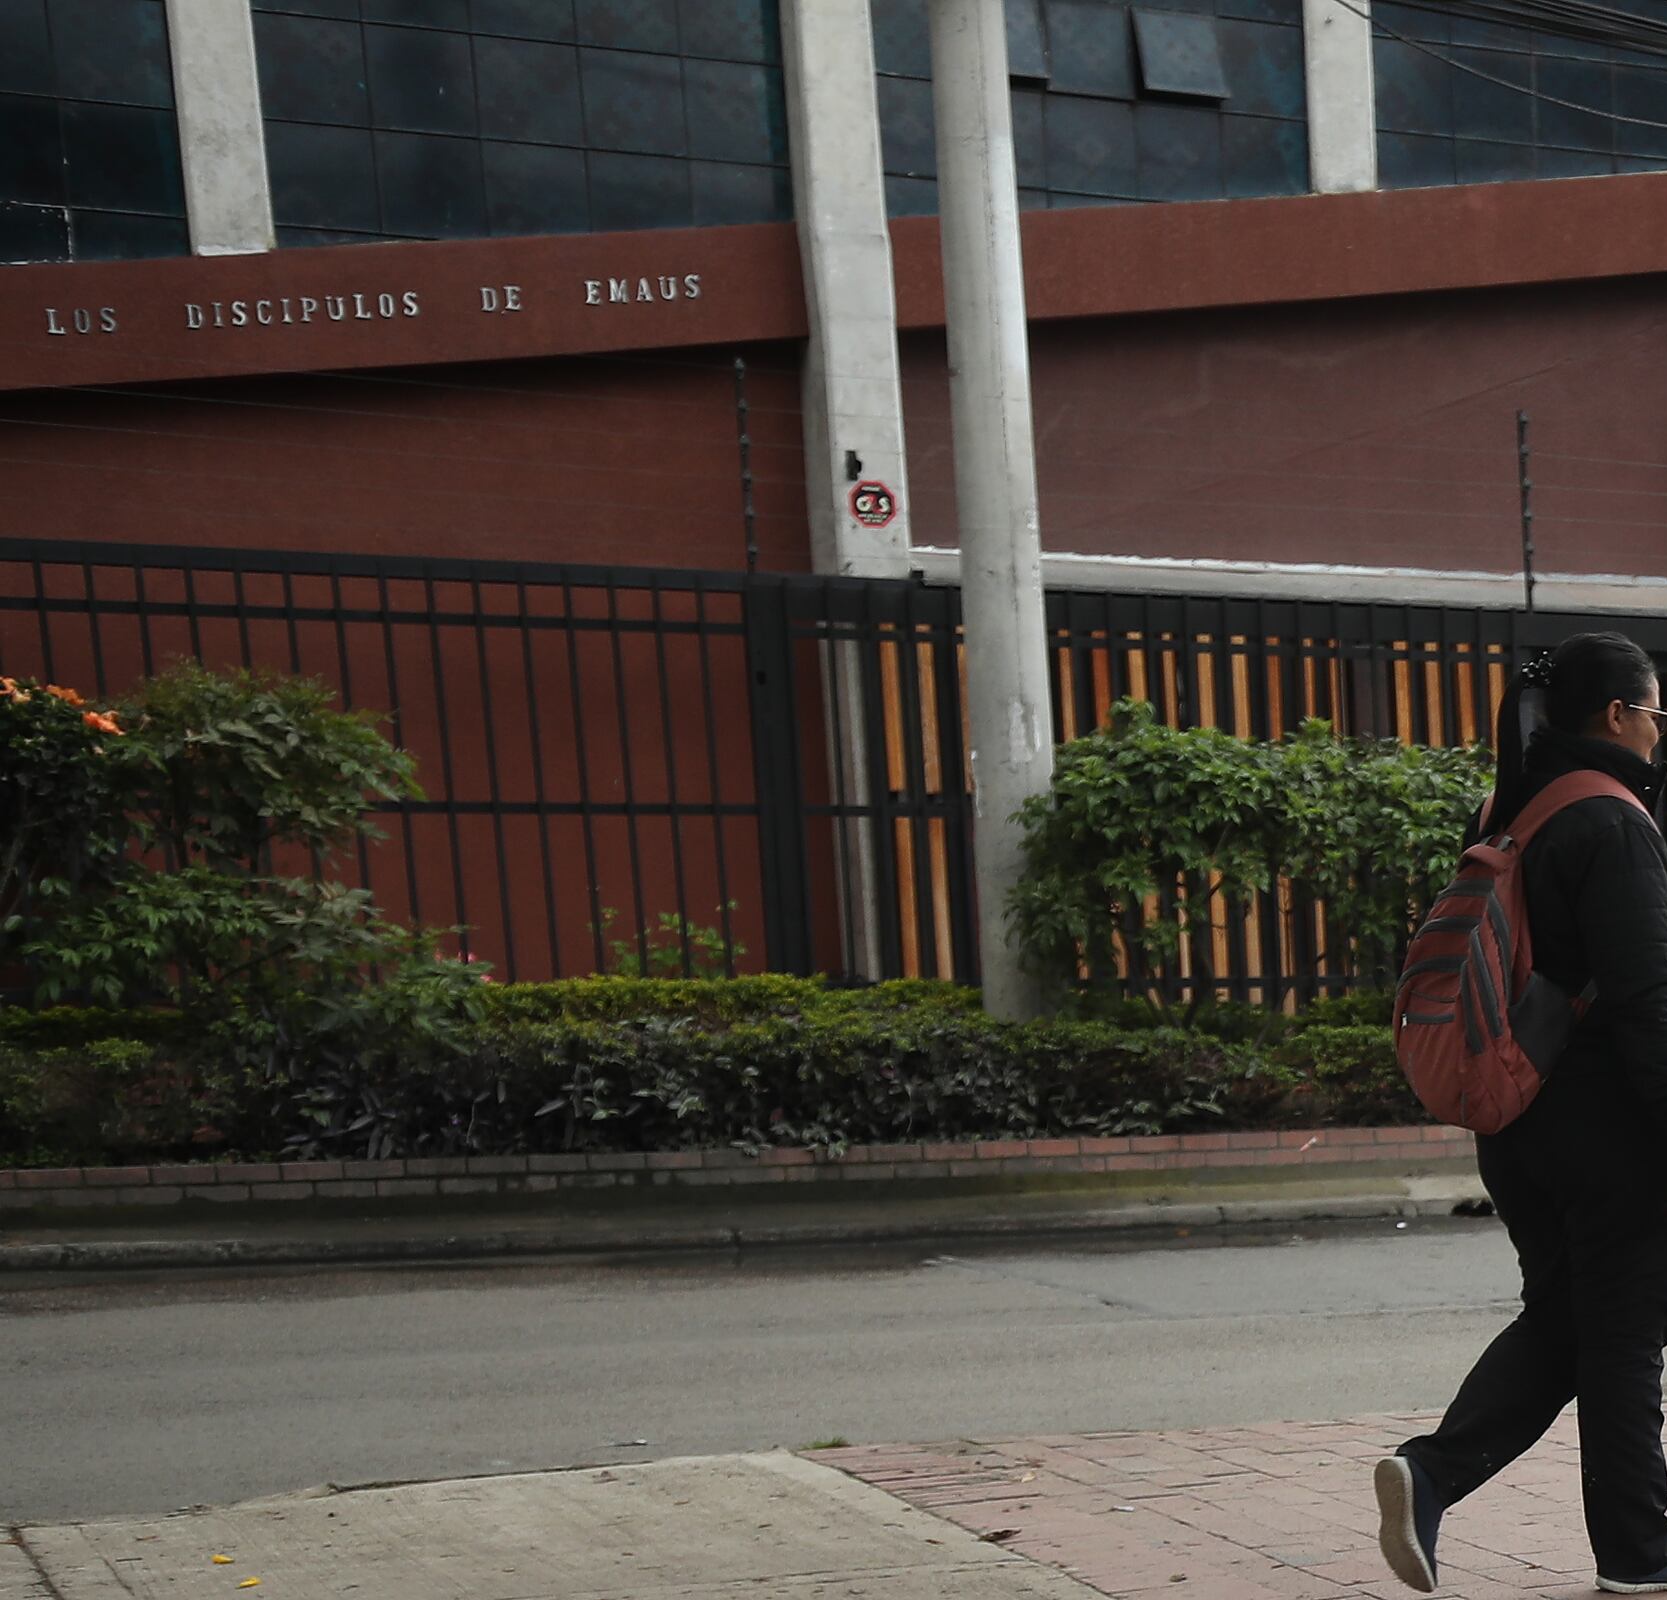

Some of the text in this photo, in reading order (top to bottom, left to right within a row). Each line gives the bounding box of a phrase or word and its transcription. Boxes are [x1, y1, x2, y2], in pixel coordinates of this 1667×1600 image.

[46, 273, 701, 335] LOS DISCIPULOS DE EMAUS
